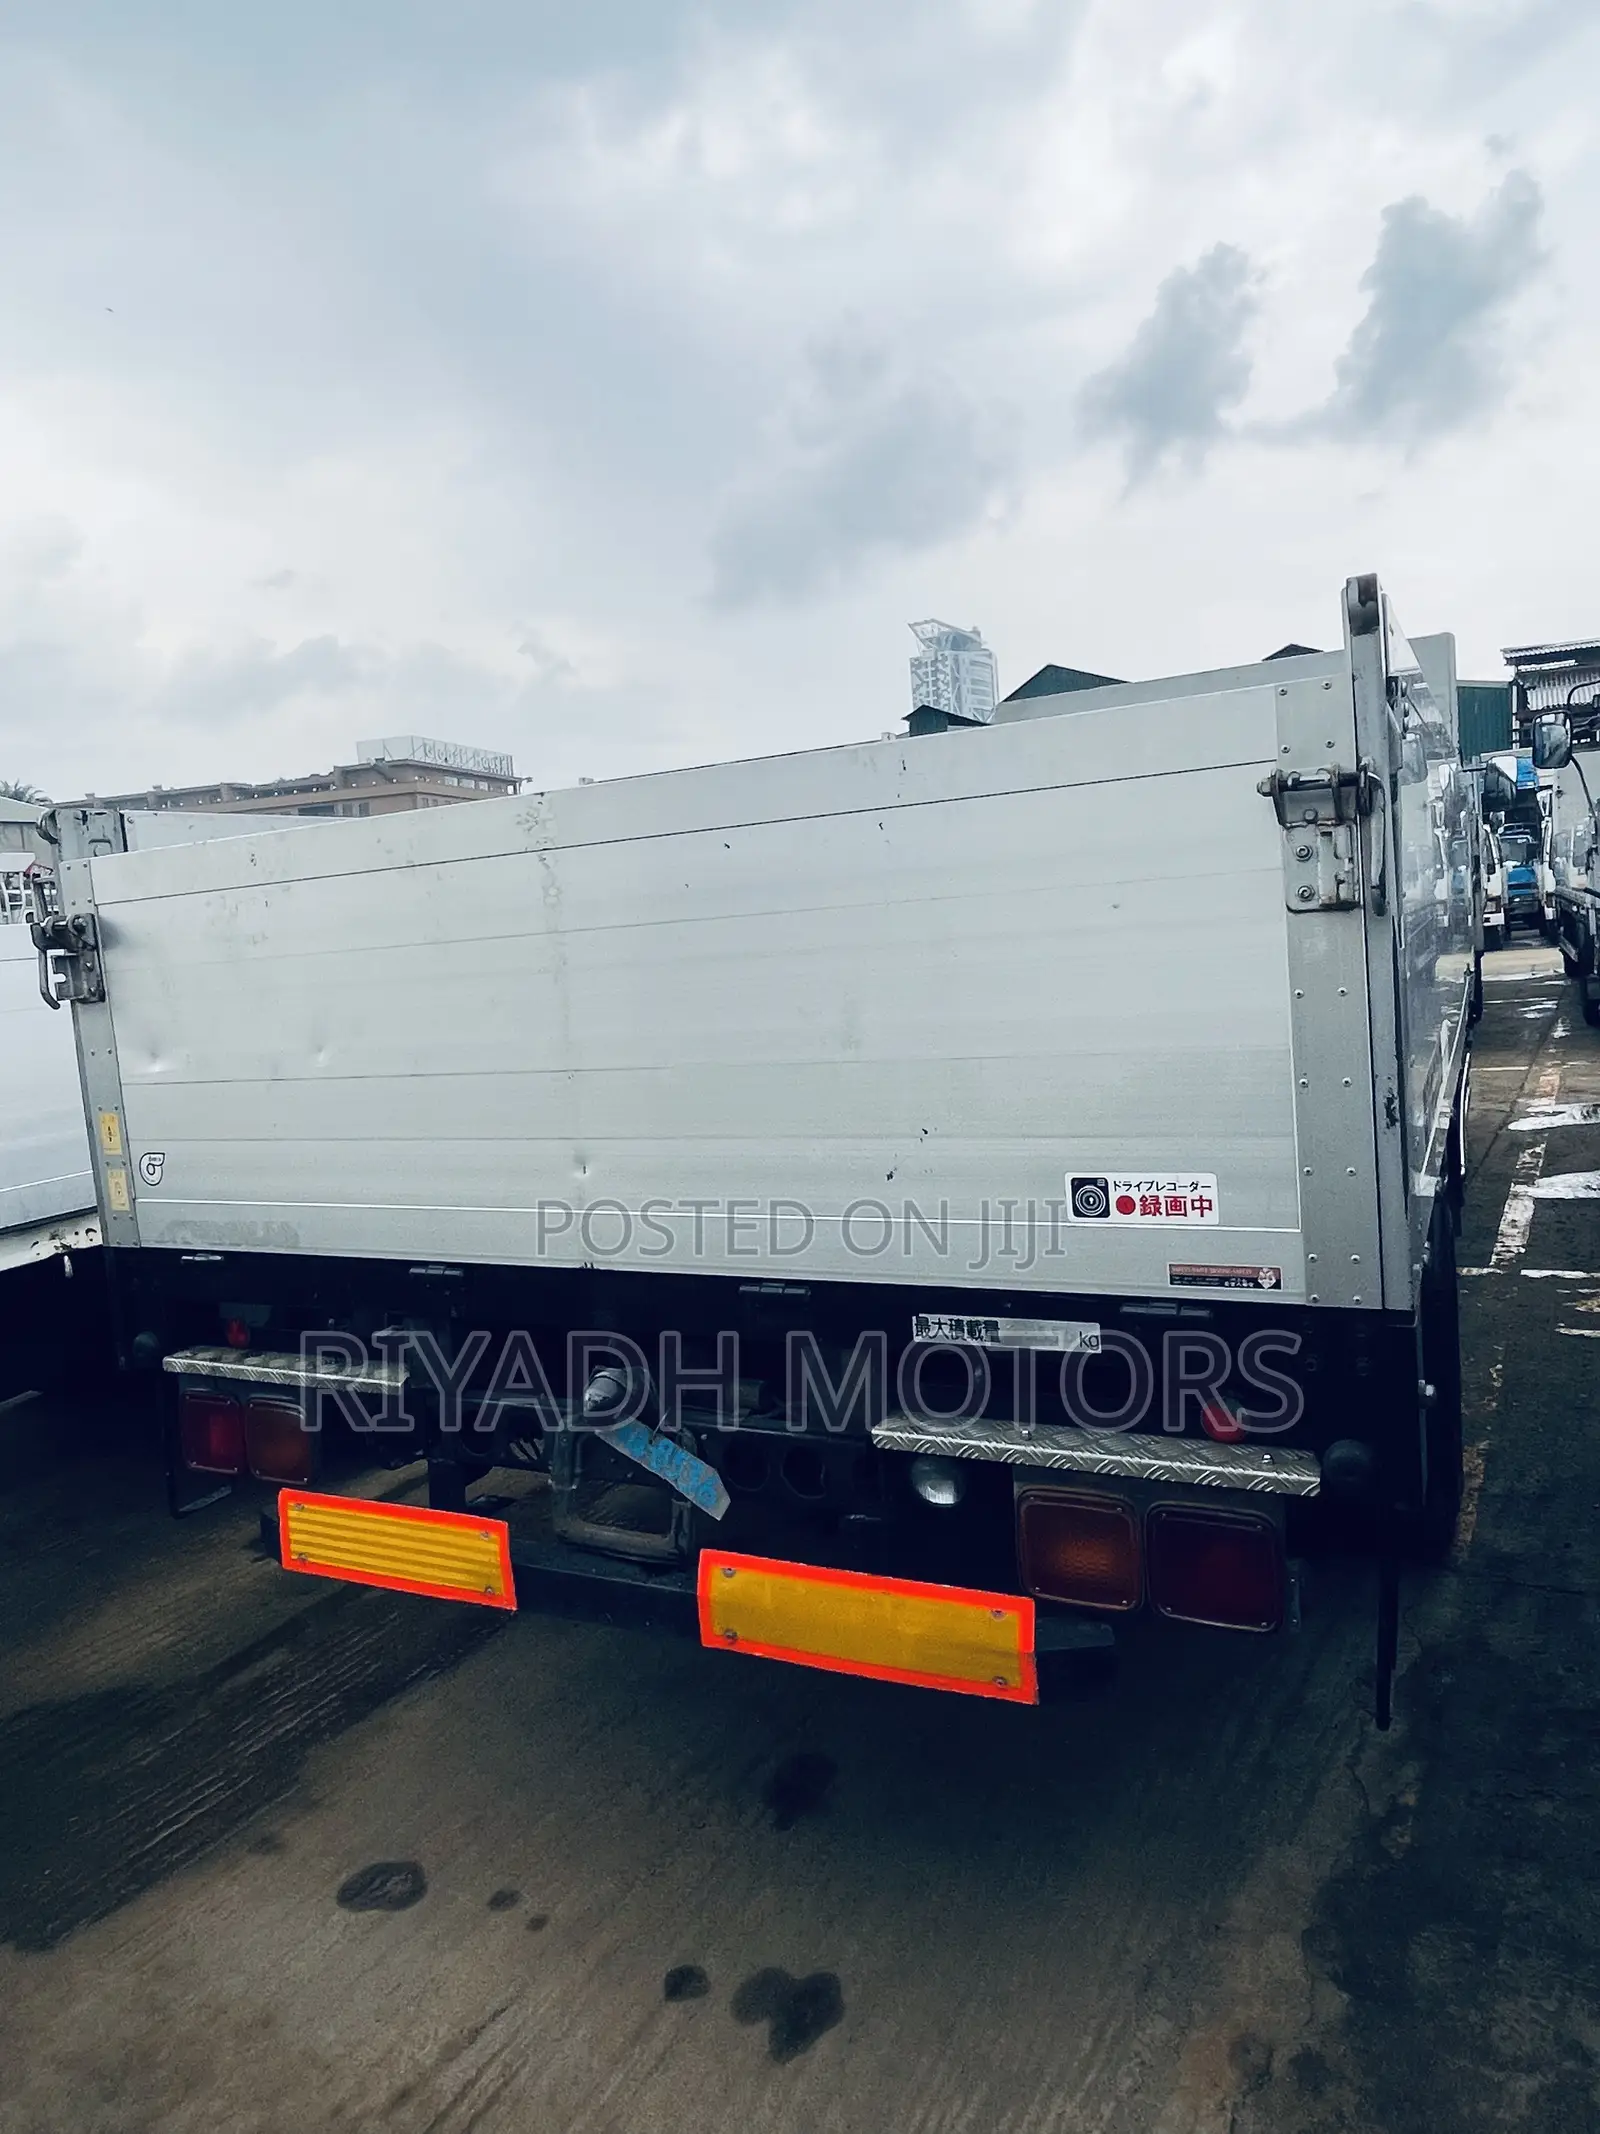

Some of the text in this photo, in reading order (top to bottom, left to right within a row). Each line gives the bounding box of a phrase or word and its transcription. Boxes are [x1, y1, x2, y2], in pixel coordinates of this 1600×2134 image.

[1112, 1179, 1212, 1193] ドライブレコーダー
[1139, 1194, 1213, 1218] 録画中
[1079, 1331, 1099, 1351] kg
